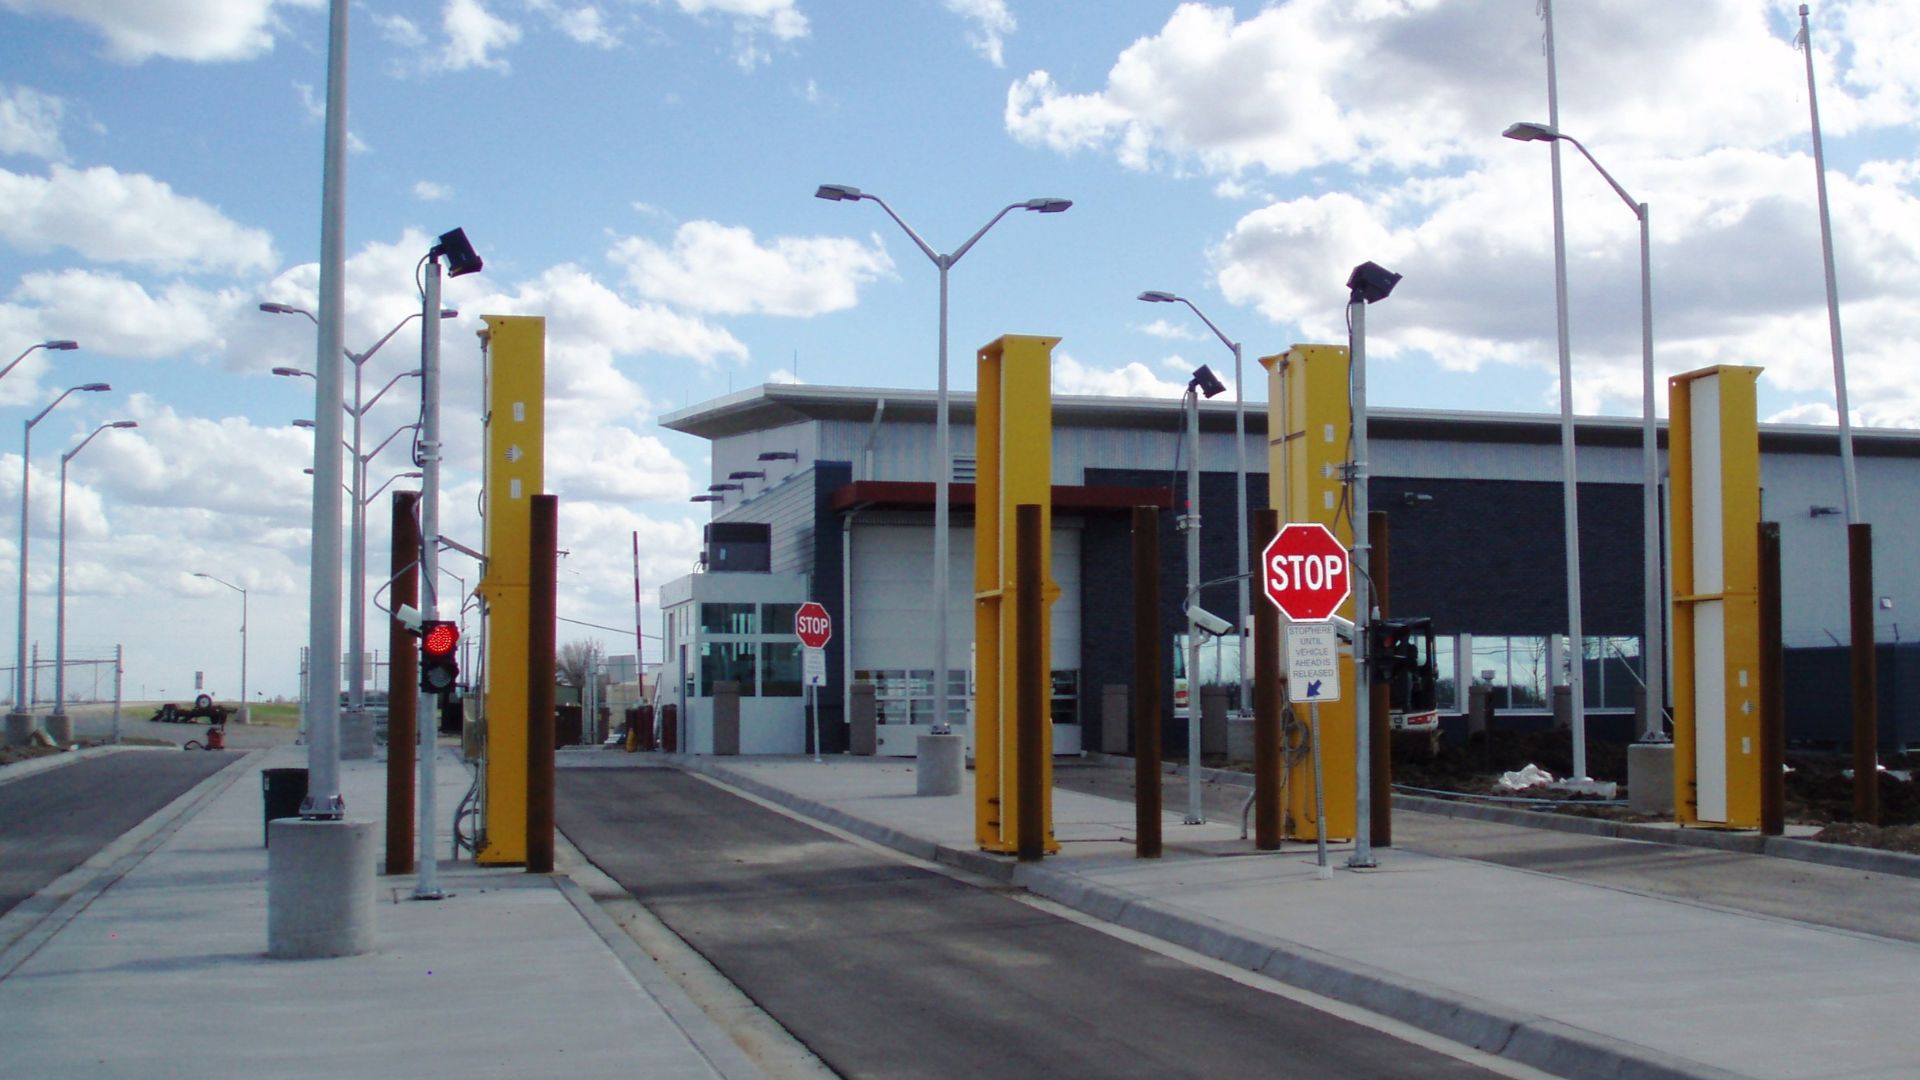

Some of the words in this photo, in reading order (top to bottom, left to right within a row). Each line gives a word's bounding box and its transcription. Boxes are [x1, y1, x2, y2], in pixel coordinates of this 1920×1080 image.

[1271, 555, 1342, 591] STOP
[799, 616, 828, 635] STOP
[1289, 627, 1311, 635] STOP
[1312, 626, 1332, 634] HERE
[1300, 637, 1322, 645] UNTIL
[1296, 648, 1328, 656] VEHICLE
[1293, 669, 1334, 678] RELEASED
